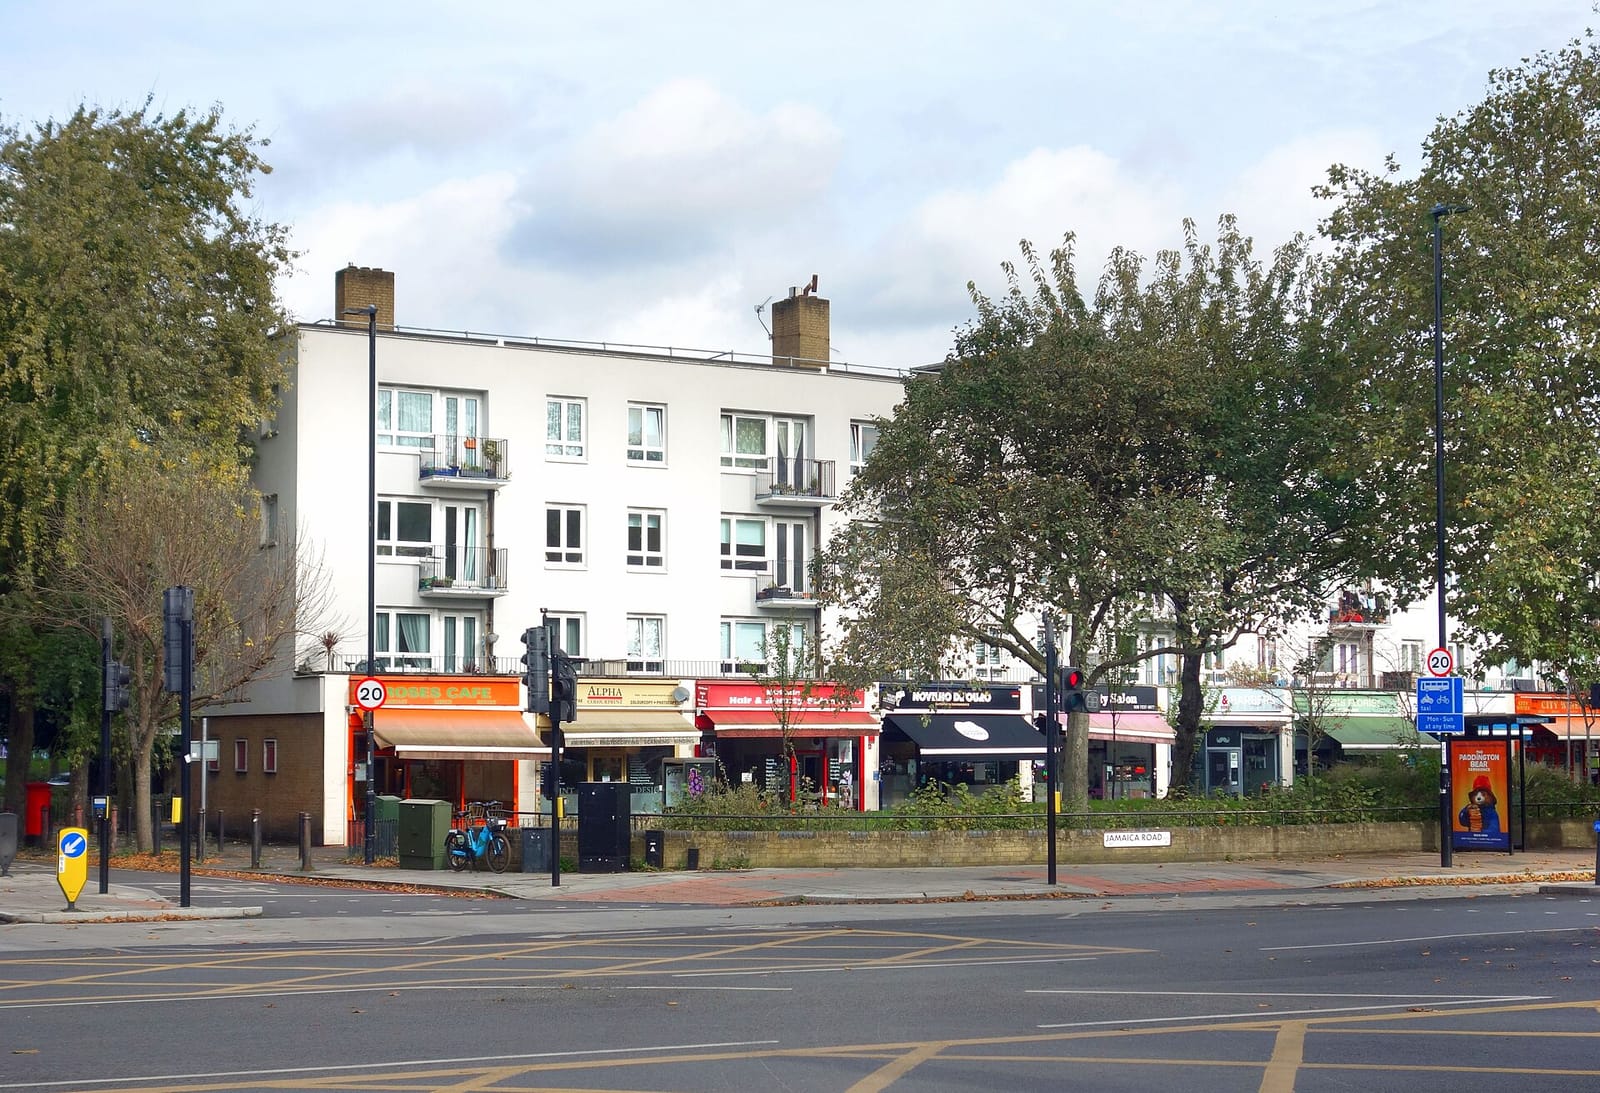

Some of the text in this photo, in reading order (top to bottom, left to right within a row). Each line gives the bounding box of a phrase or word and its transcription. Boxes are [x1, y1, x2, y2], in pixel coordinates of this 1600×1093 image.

[1431, 656, 1449, 668] 20
[360, 687, 382, 701] 20
[446, 687, 492, 698] CAFE
[912, 691, 952, 702] NOVILHO
[729, 696, 752, 704] Hair
[754, 696, 762, 704] &
[1110, 693, 1138, 704] Salon
[1459, 753, 1500, 761] PADDINGTON
[1470, 760, 1488, 768] BEAR
[635, 786, 661, 794] DESIG
[1105, 833, 1163, 842] JAMAICA ROAD
